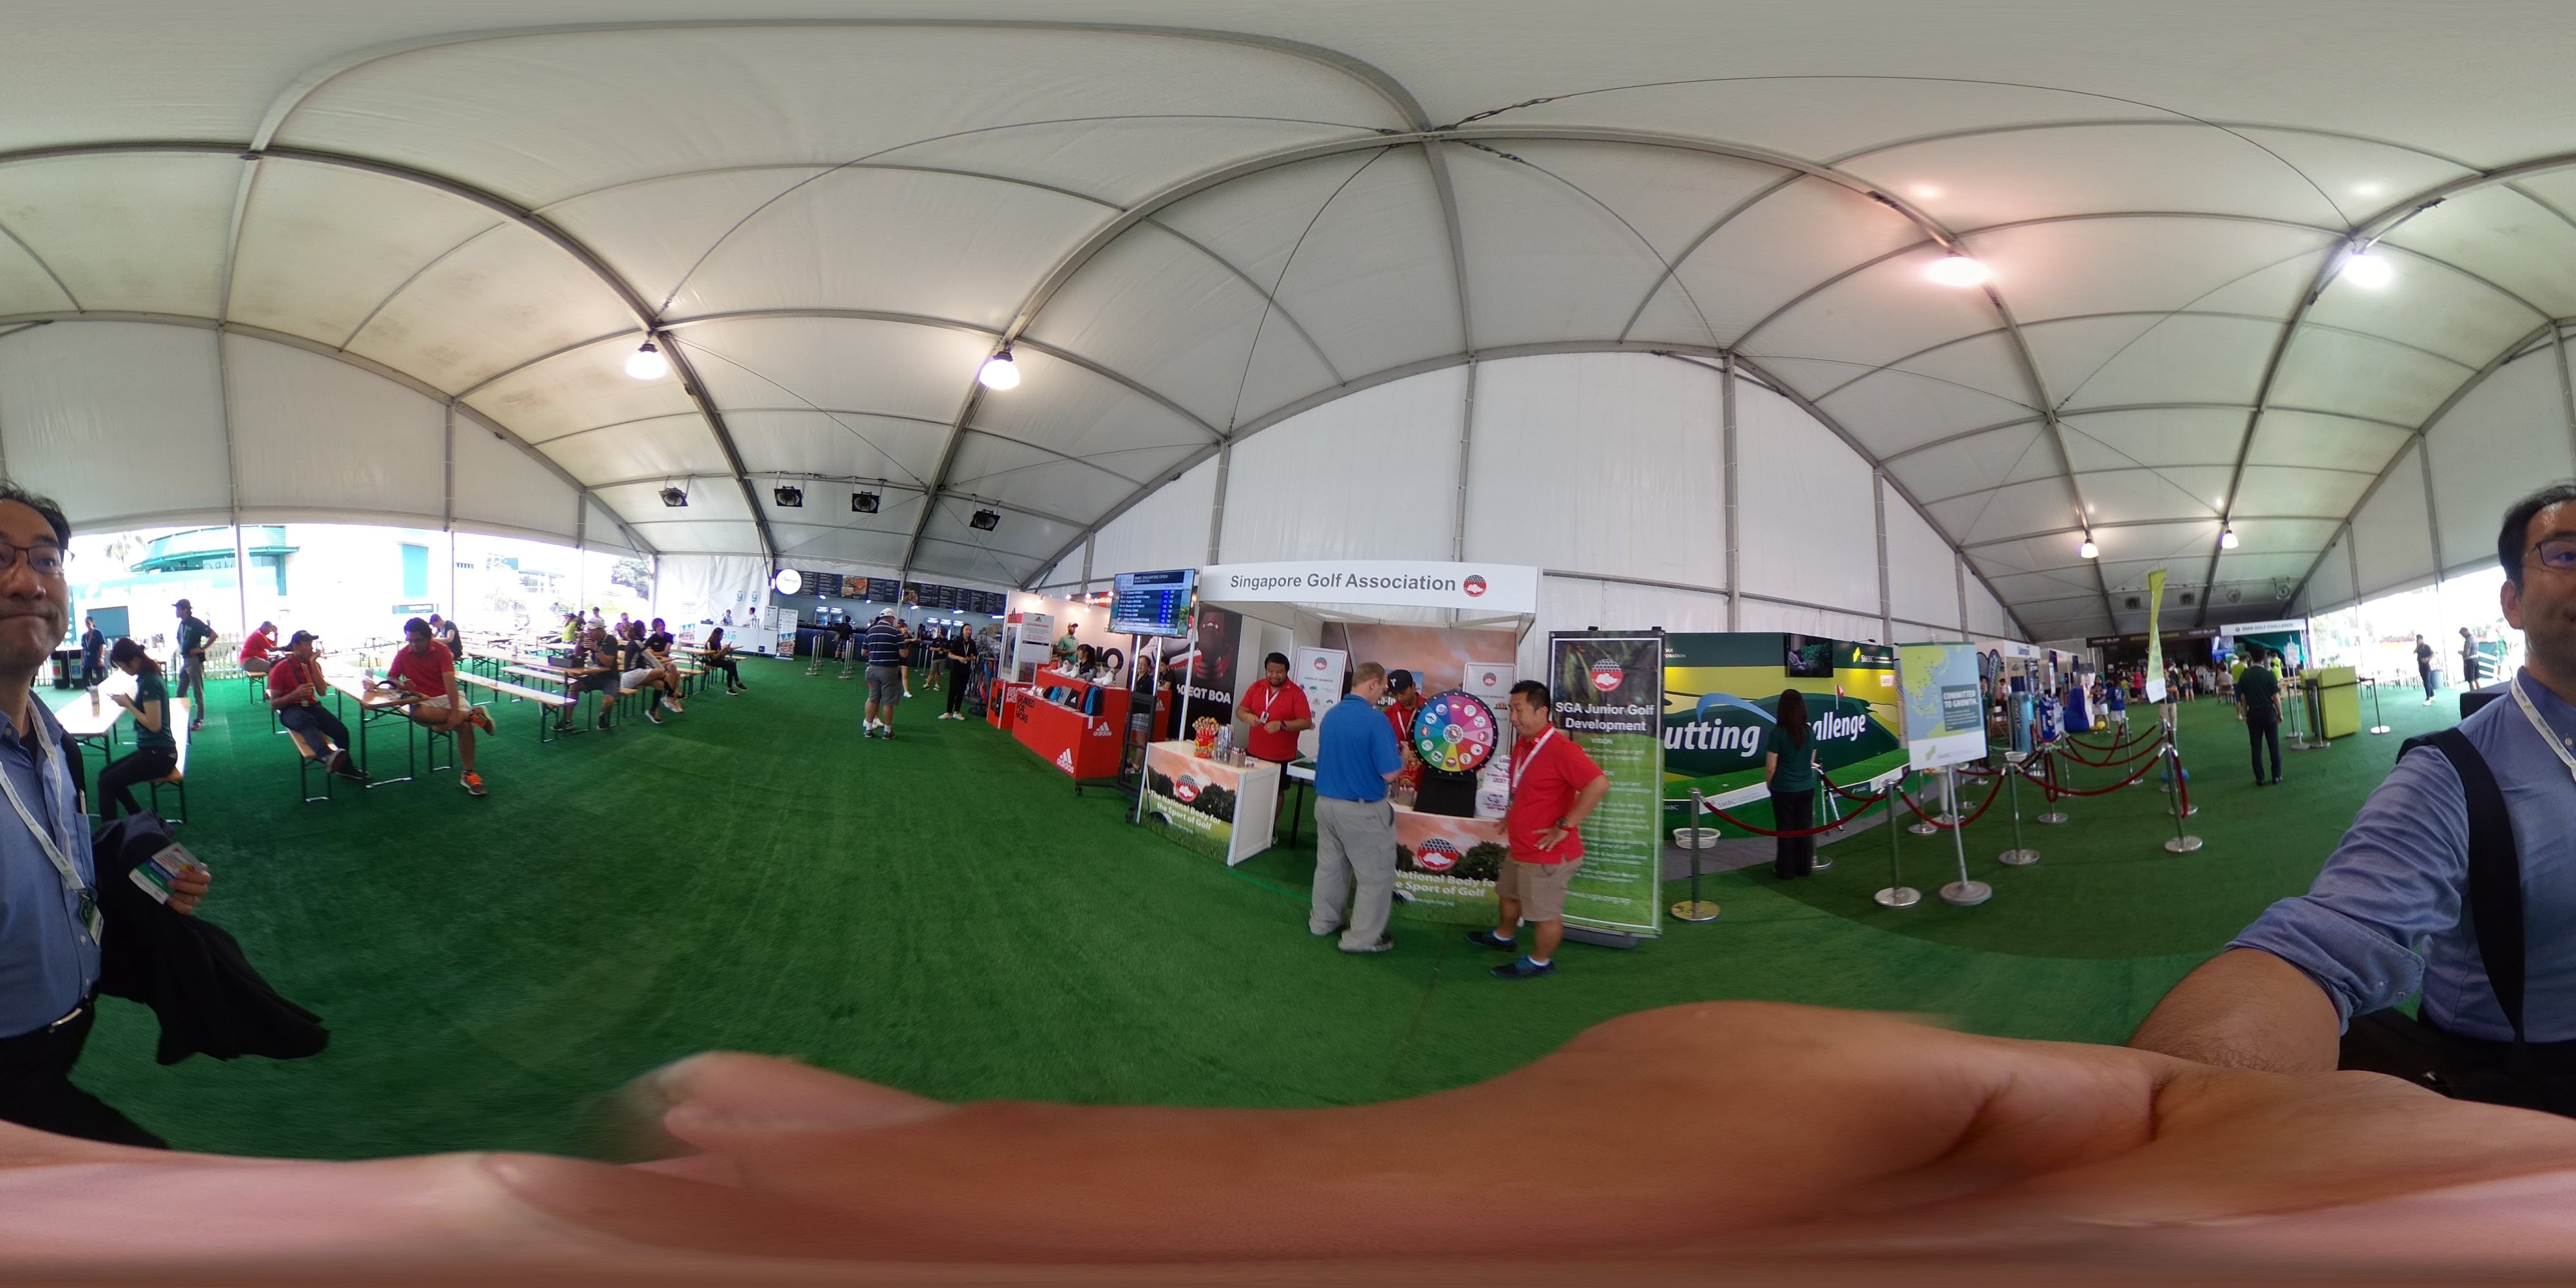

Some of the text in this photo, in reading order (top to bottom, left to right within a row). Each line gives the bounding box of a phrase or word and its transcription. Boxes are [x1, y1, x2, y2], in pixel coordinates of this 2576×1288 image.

[1231, 573, 1455, 591] Singapore Golf Association
[1208, 690, 1231, 705] BOA
[1944, 690, 1976, 699] COMMITTED
[1555, 702, 1655, 715] SGA Junior Golf
[1565, 717, 1647, 732] Development
[1663, 718, 1761, 757] utting
[1057, 758, 1074, 773] adidas
[1151, 791, 1222, 825] The National Body for
[1718, 799, 1736, 808] SMBC
[1157, 802, 1167, 812] the
[1168, 806, 1187, 820] Sport
[1196, 819, 1212, 831] Golf
[1447, 875, 1480, 887] Body
[1405, 881, 1486, 897] Sport of Golf
